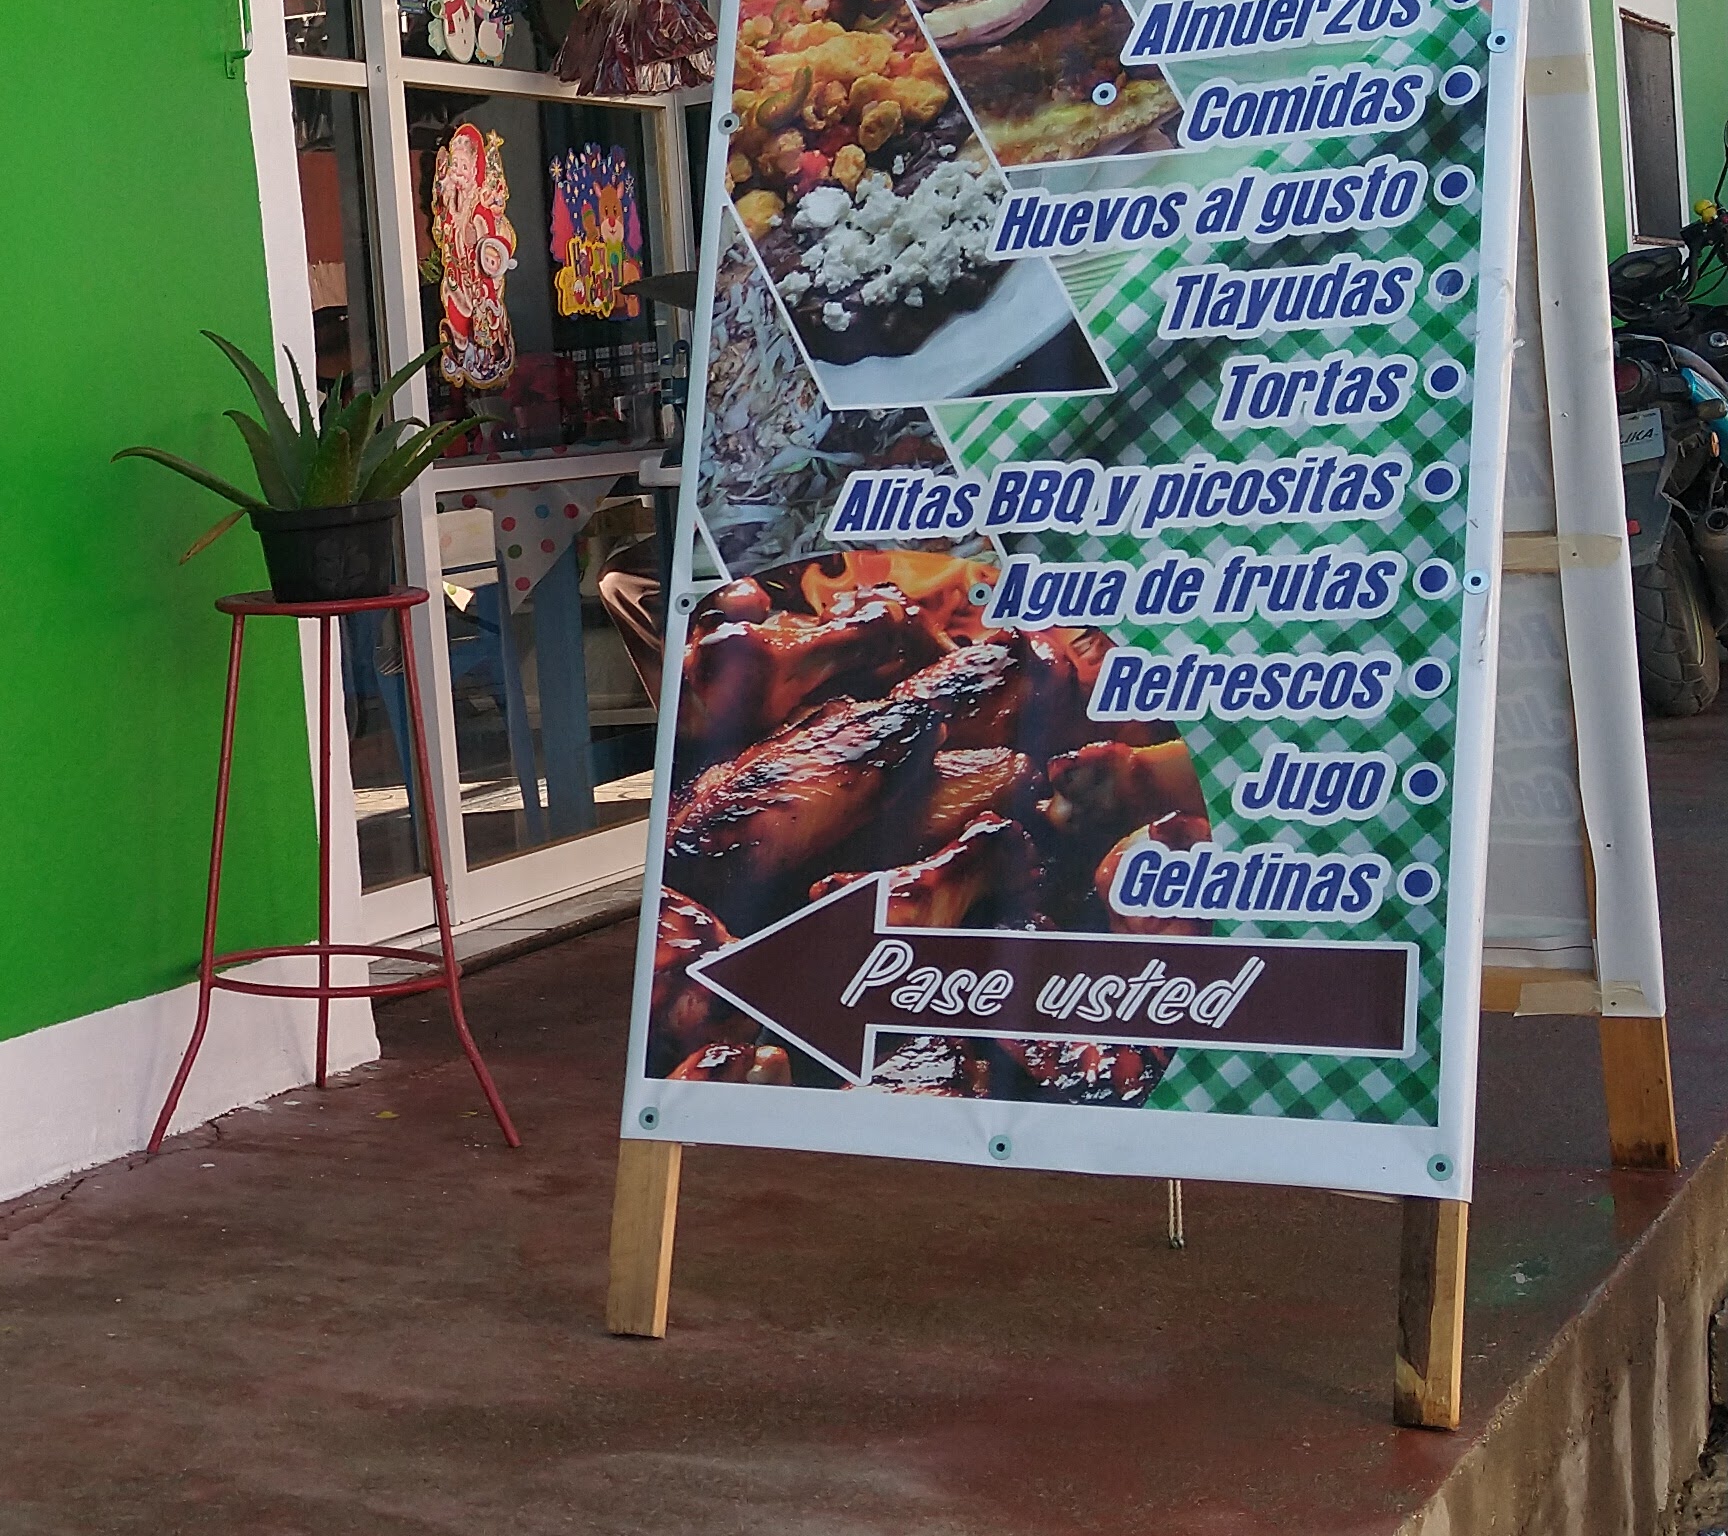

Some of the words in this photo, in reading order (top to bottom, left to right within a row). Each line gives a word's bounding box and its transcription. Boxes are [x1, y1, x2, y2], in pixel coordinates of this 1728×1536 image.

[1188, 70, 1419, 141] Comidas
[996, 192, 1183, 251] Huevos
[1196, 177, 1249, 233] al
[1258, 162, 1418, 238] gusto
[1169, 260, 1413, 330] Tlayudas
[1223, 359, 1407, 420] Tortas
[835, 473, 978, 532] Alitas
[986, 469, 1096, 526] BBQ
[1100, 475, 1137, 526] y
[1141, 457, 1402, 528] picositas
[993, 564, 1122, 621] Agua
[1135, 560, 1202, 615] de
[1217, 555, 1396, 612] frutas
[1098, 654, 1391, 711] Refrescos
[1242, 753, 1385, 815] Jugo
[1120, 851, 1380, 912] Gelatinas
[842, 939, 1015, 1015] Pase
[1035, 956, 1264, 1028] usted
